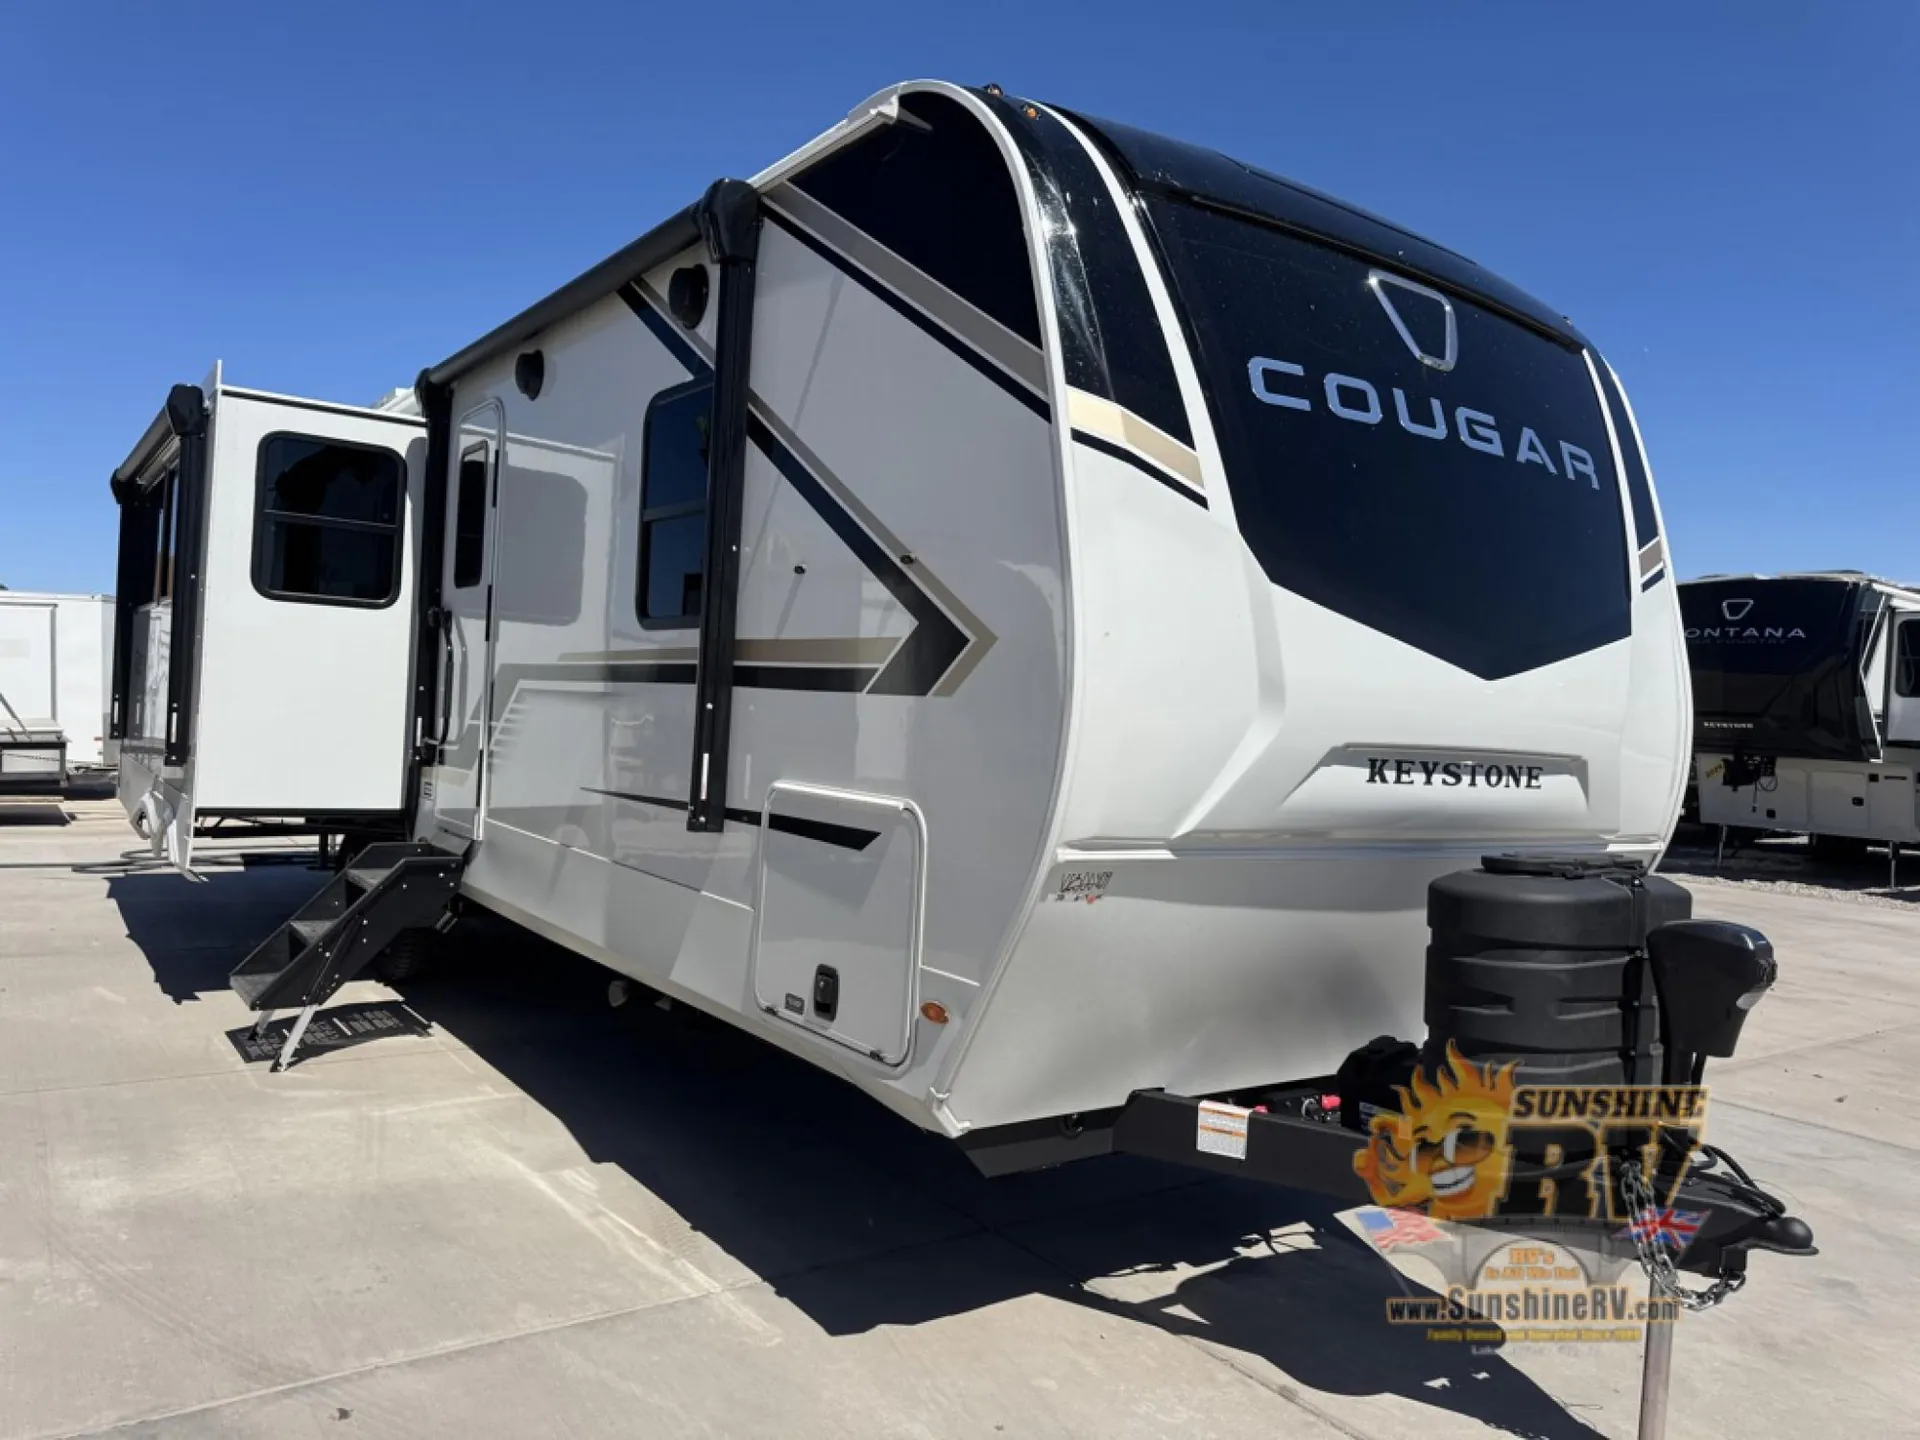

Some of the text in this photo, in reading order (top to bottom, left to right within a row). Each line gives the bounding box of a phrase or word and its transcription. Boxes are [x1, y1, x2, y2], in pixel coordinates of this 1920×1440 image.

[1247, 356, 1600, 490] COUGAR
[1685, 627, 1807, 638] ONTANA
[1366, 758, 1544, 790] KEYSTONE
